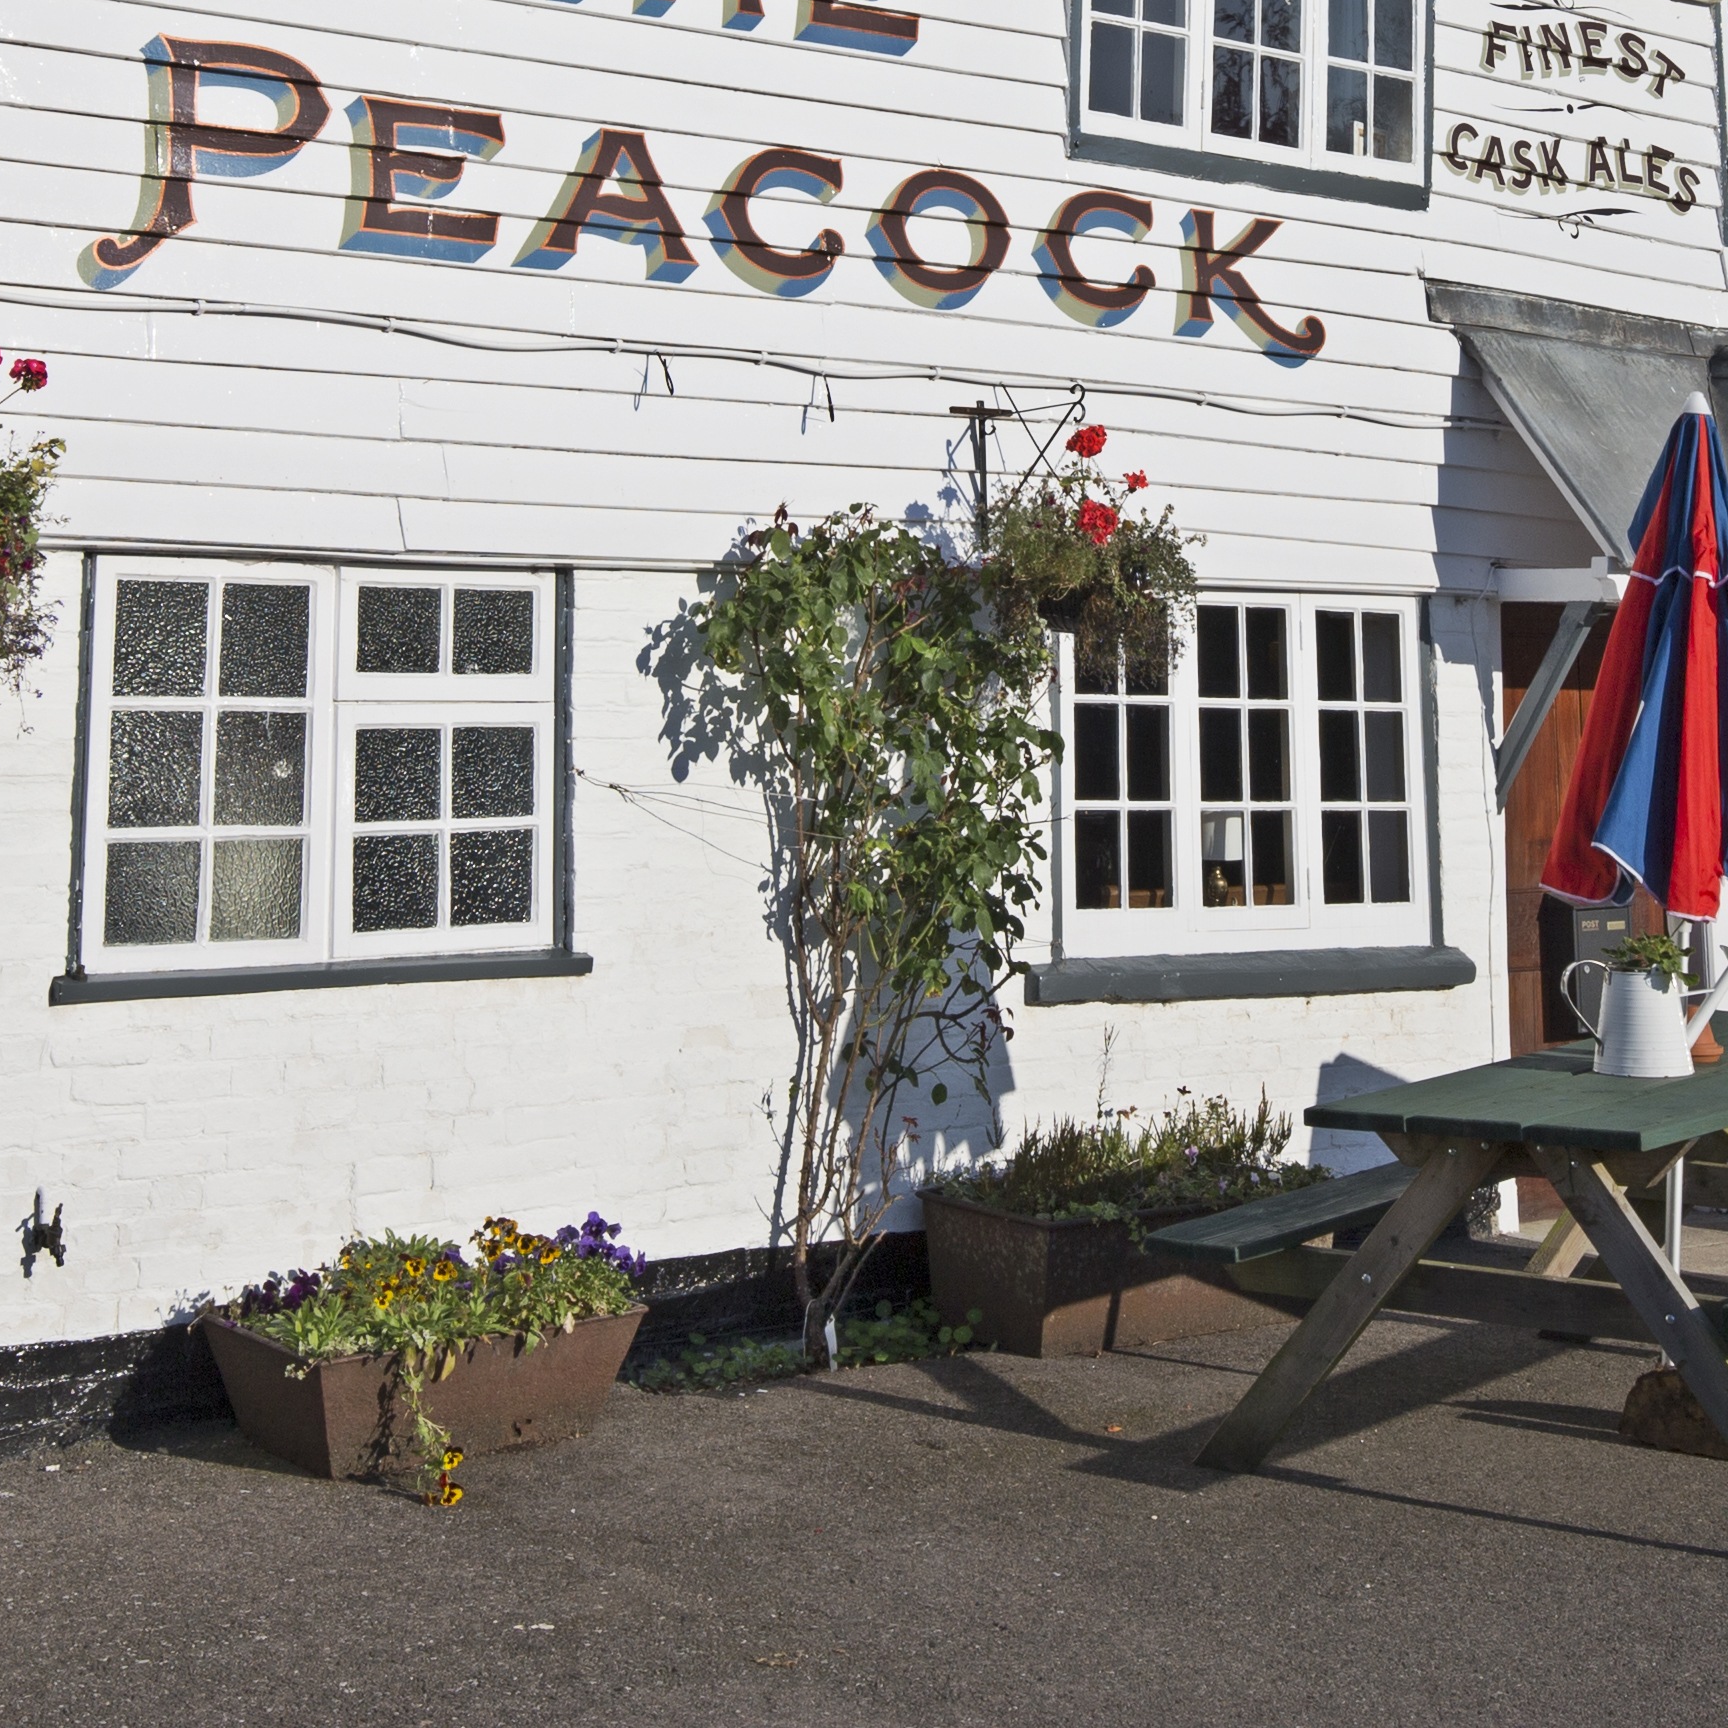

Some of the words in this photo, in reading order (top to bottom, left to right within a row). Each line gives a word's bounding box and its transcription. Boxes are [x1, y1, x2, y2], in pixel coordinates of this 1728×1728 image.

[1479, 20, 1686, 99] FINEST
[77, 32, 1326, 367] PEACOCK
[1440, 123, 1569, 196] CASK
[1575, 135, 1701, 216] ALES
[1581, 919, 1599, 929] POST
